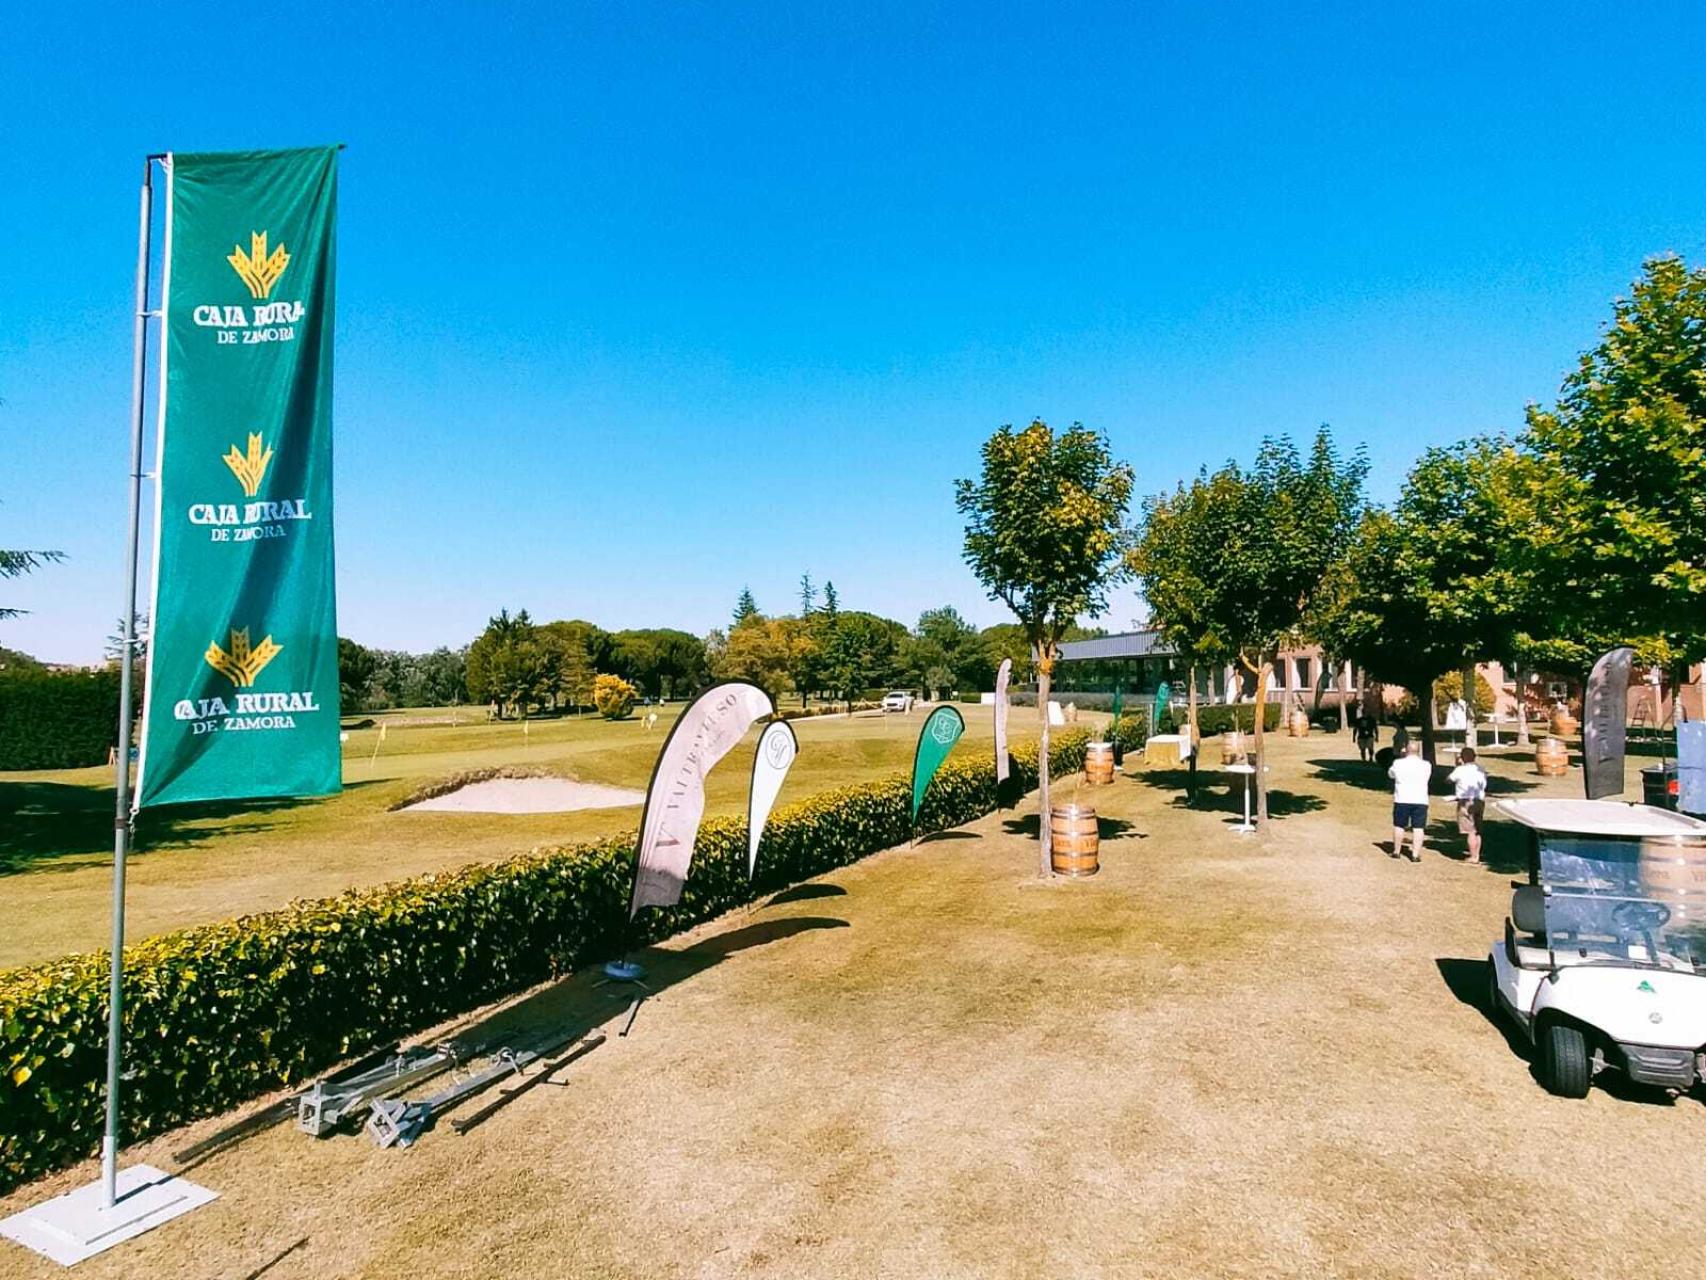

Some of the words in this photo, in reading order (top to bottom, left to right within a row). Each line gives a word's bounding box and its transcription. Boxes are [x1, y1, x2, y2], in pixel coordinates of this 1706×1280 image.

[193, 304, 249, 328] CAJA
[217, 330, 238, 344] DE
[242, 327, 295, 344] ZAMORA
[188, 503, 240, 526] CAJA
[242, 499, 313, 524] RURAL
[211, 528, 230, 541] DE
[174, 697, 230, 720] CAJA
[235, 691, 320, 714] RURAL
[192, 720, 218, 735] DE
[223, 716, 296, 731] ZAMORA
